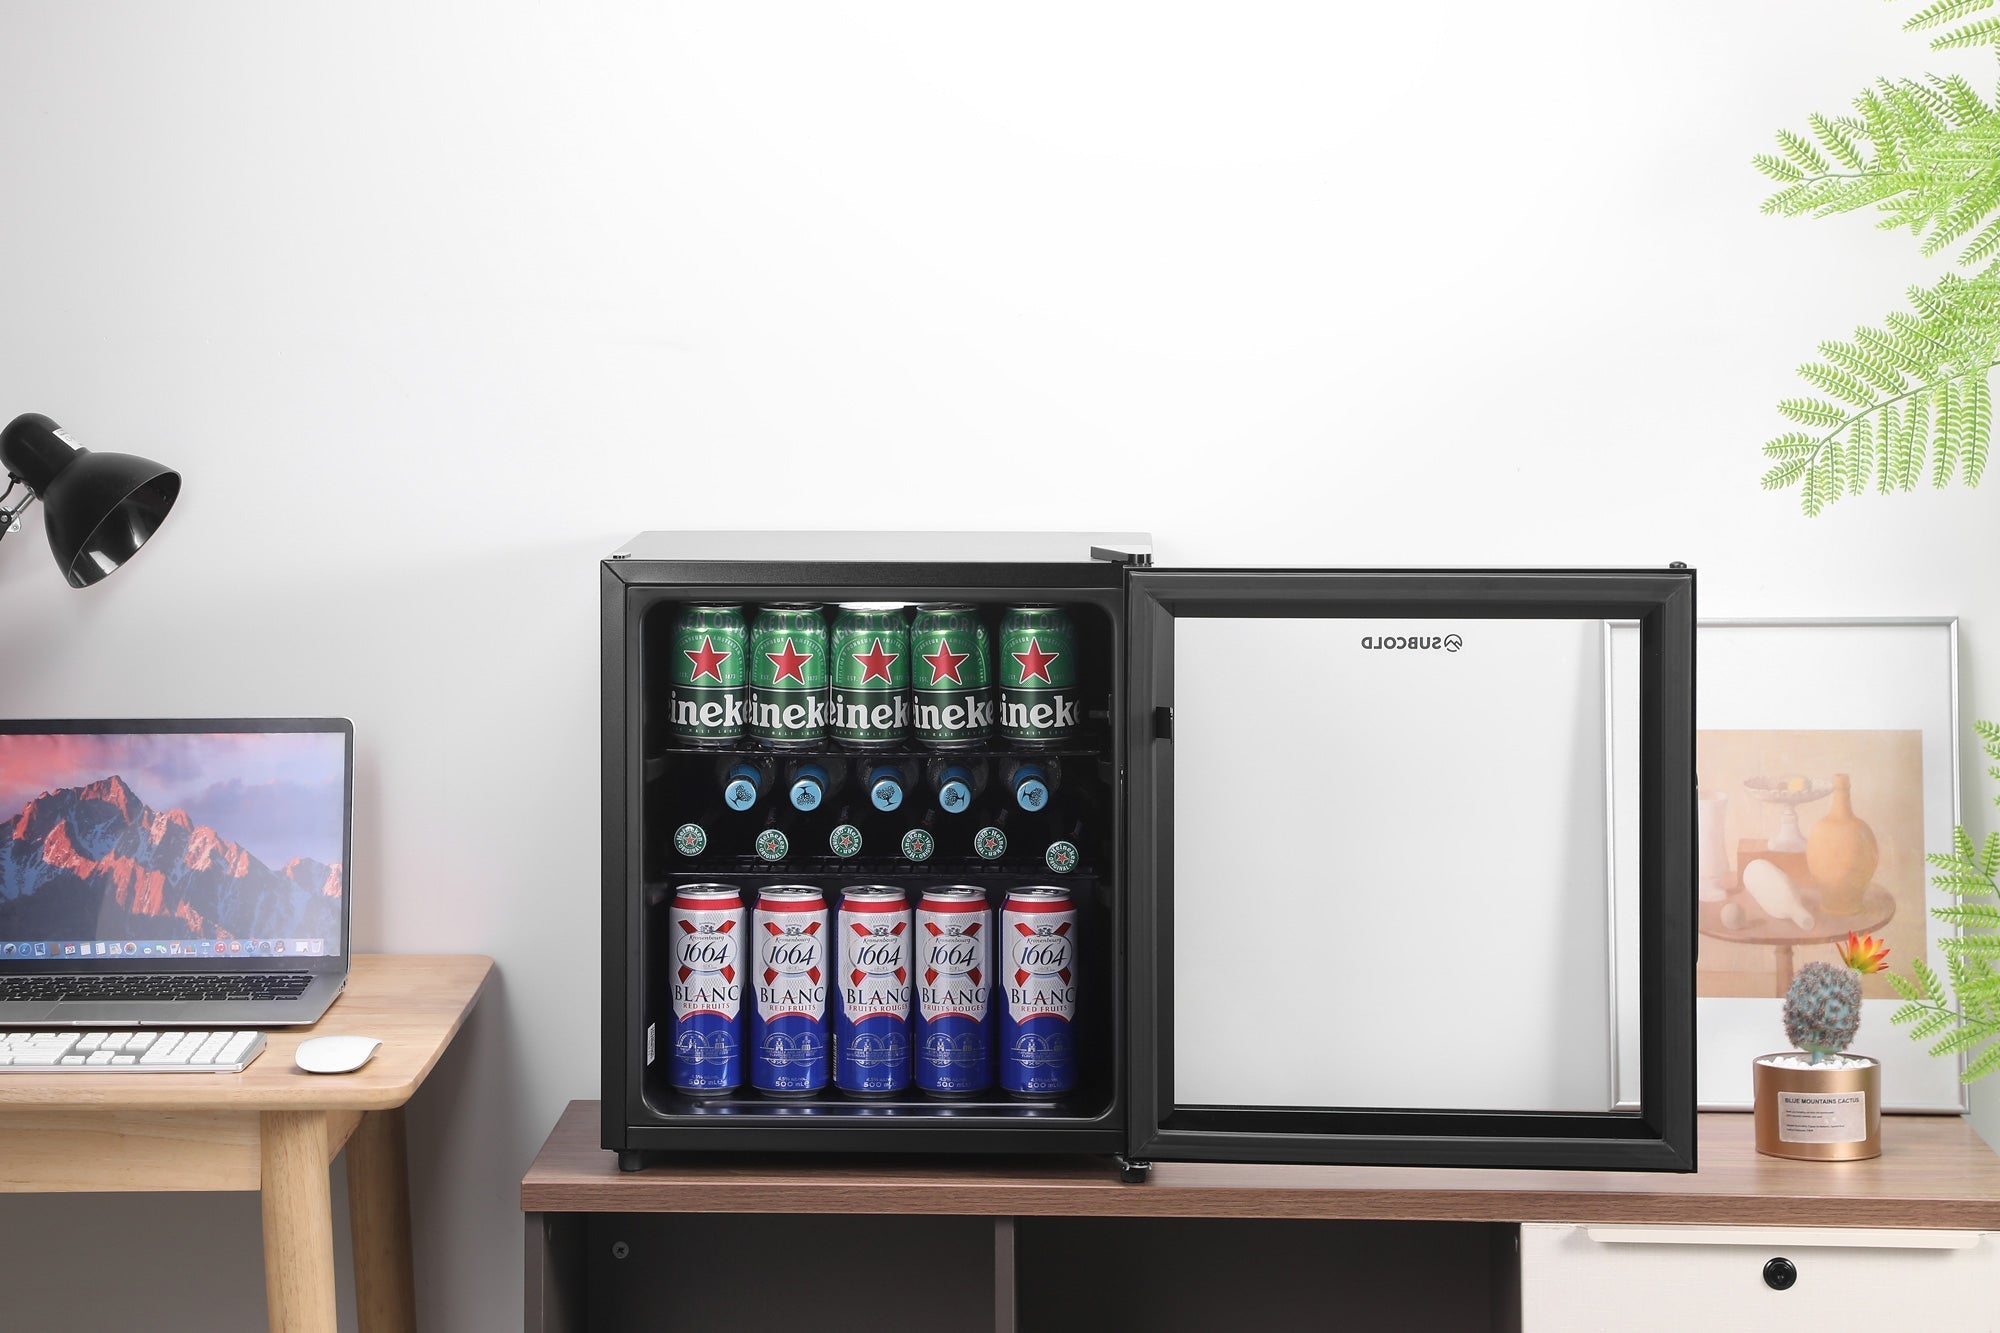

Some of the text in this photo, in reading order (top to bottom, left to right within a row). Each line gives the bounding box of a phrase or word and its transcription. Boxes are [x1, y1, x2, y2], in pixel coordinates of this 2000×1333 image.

[676, 826, 702, 842] Heineken
[758, 831, 785, 850] Heineken
[843, 827, 859, 854] Heineken
[988, 830, 1003, 856] Heineken
[905, 832, 923, 858] Heineken
[1050, 843, 1076, 864] Heineken
[683, 941, 730, 964] 1664
[769, 942, 816, 965] 1664
[857, 943, 903, 966] 1664
[930, 943, 977, 966] 1664
[1020, 943, 1068, 966] 1664
[675, 985, 739, 1003] BLANC
[760, 987, 824, 1004] BLANC
[847, 986, 909, 1005] BLANC
[922, 987, 986, 1005] BLANC
[1011, 987, 1075, 1005] BLANC
[683, 1002, 730, 1010] RED FRUITS
[788, 1004, 816, 1012] FRUITS
[880, 1004, 908, 1012] ROUGES
[923, 1004, 984, 1012] FRUITS ROUGES
[775, 1080, 793, 1088] 500
